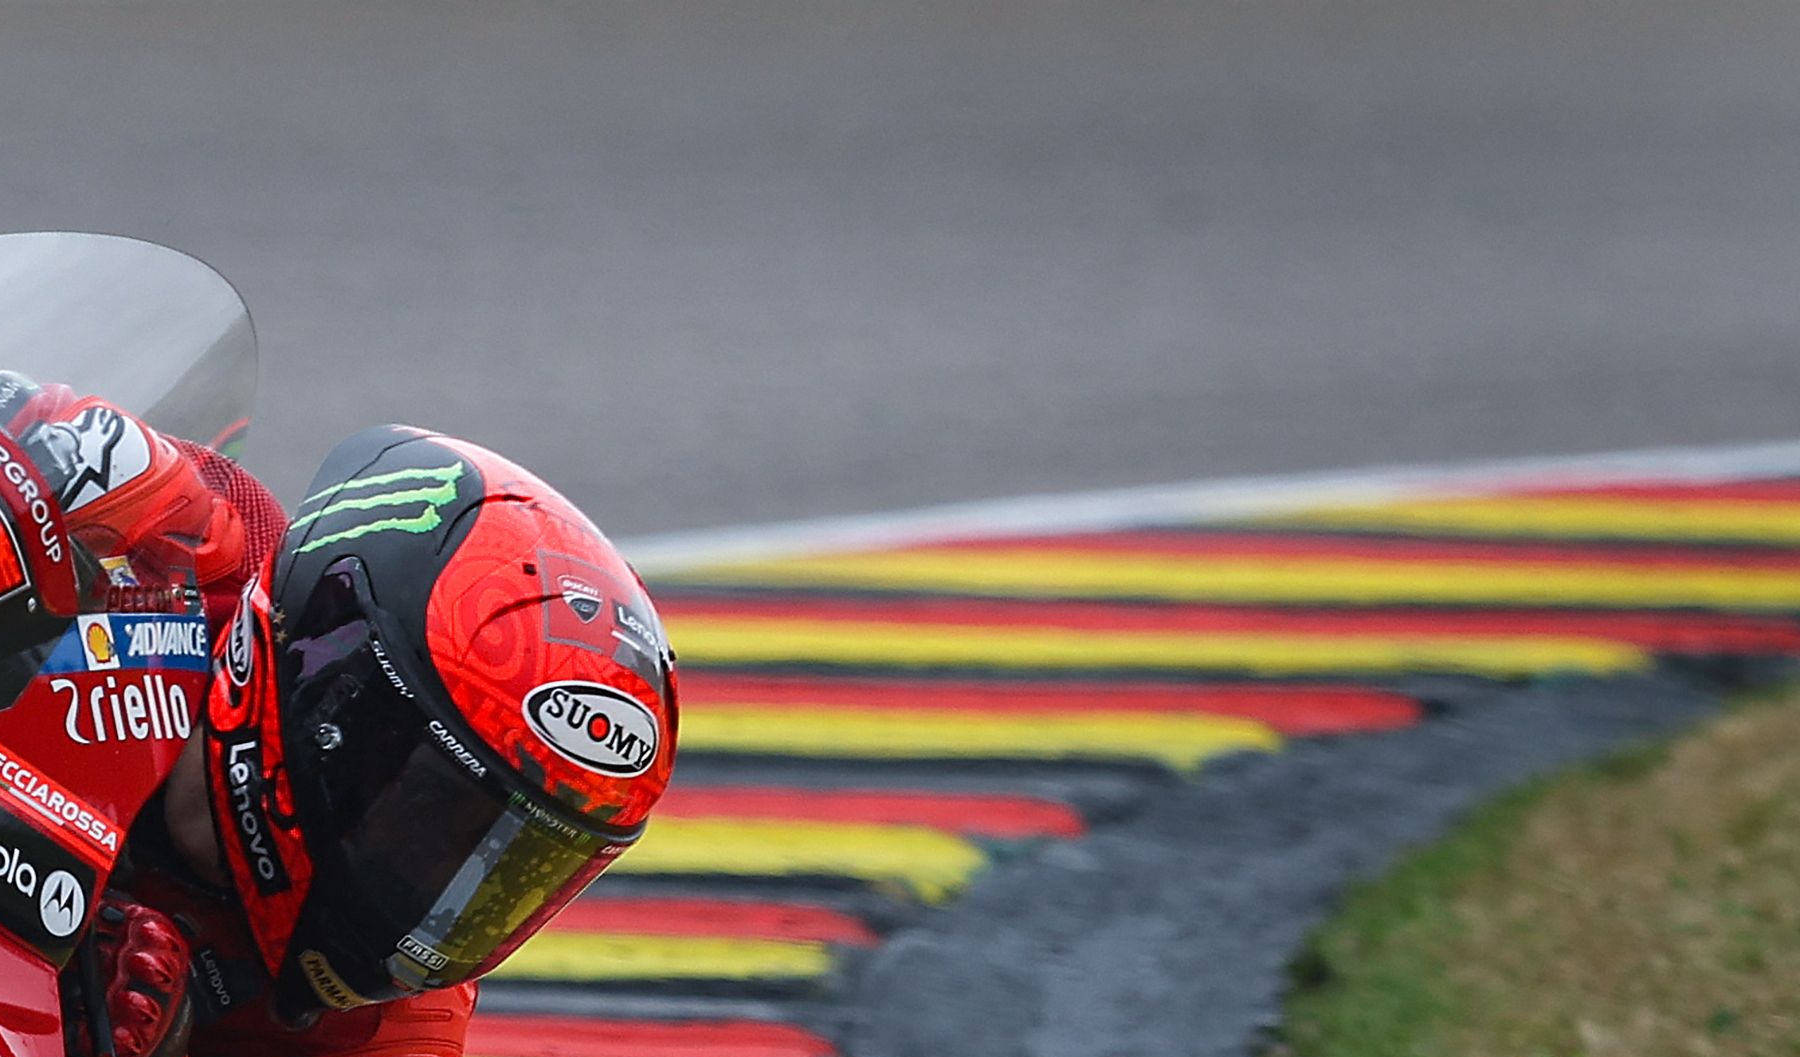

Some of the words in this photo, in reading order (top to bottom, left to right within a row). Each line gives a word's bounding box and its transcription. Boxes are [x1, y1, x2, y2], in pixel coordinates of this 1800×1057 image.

[128, 621, 206, 657] ADVANCE
[429, 720, 488, 778] CARRERA
[546, 688, 652, 771] SUOMY
[229, 740, 276, 881] Lenovo
[200, 949, 231, 1005] Lenovo
